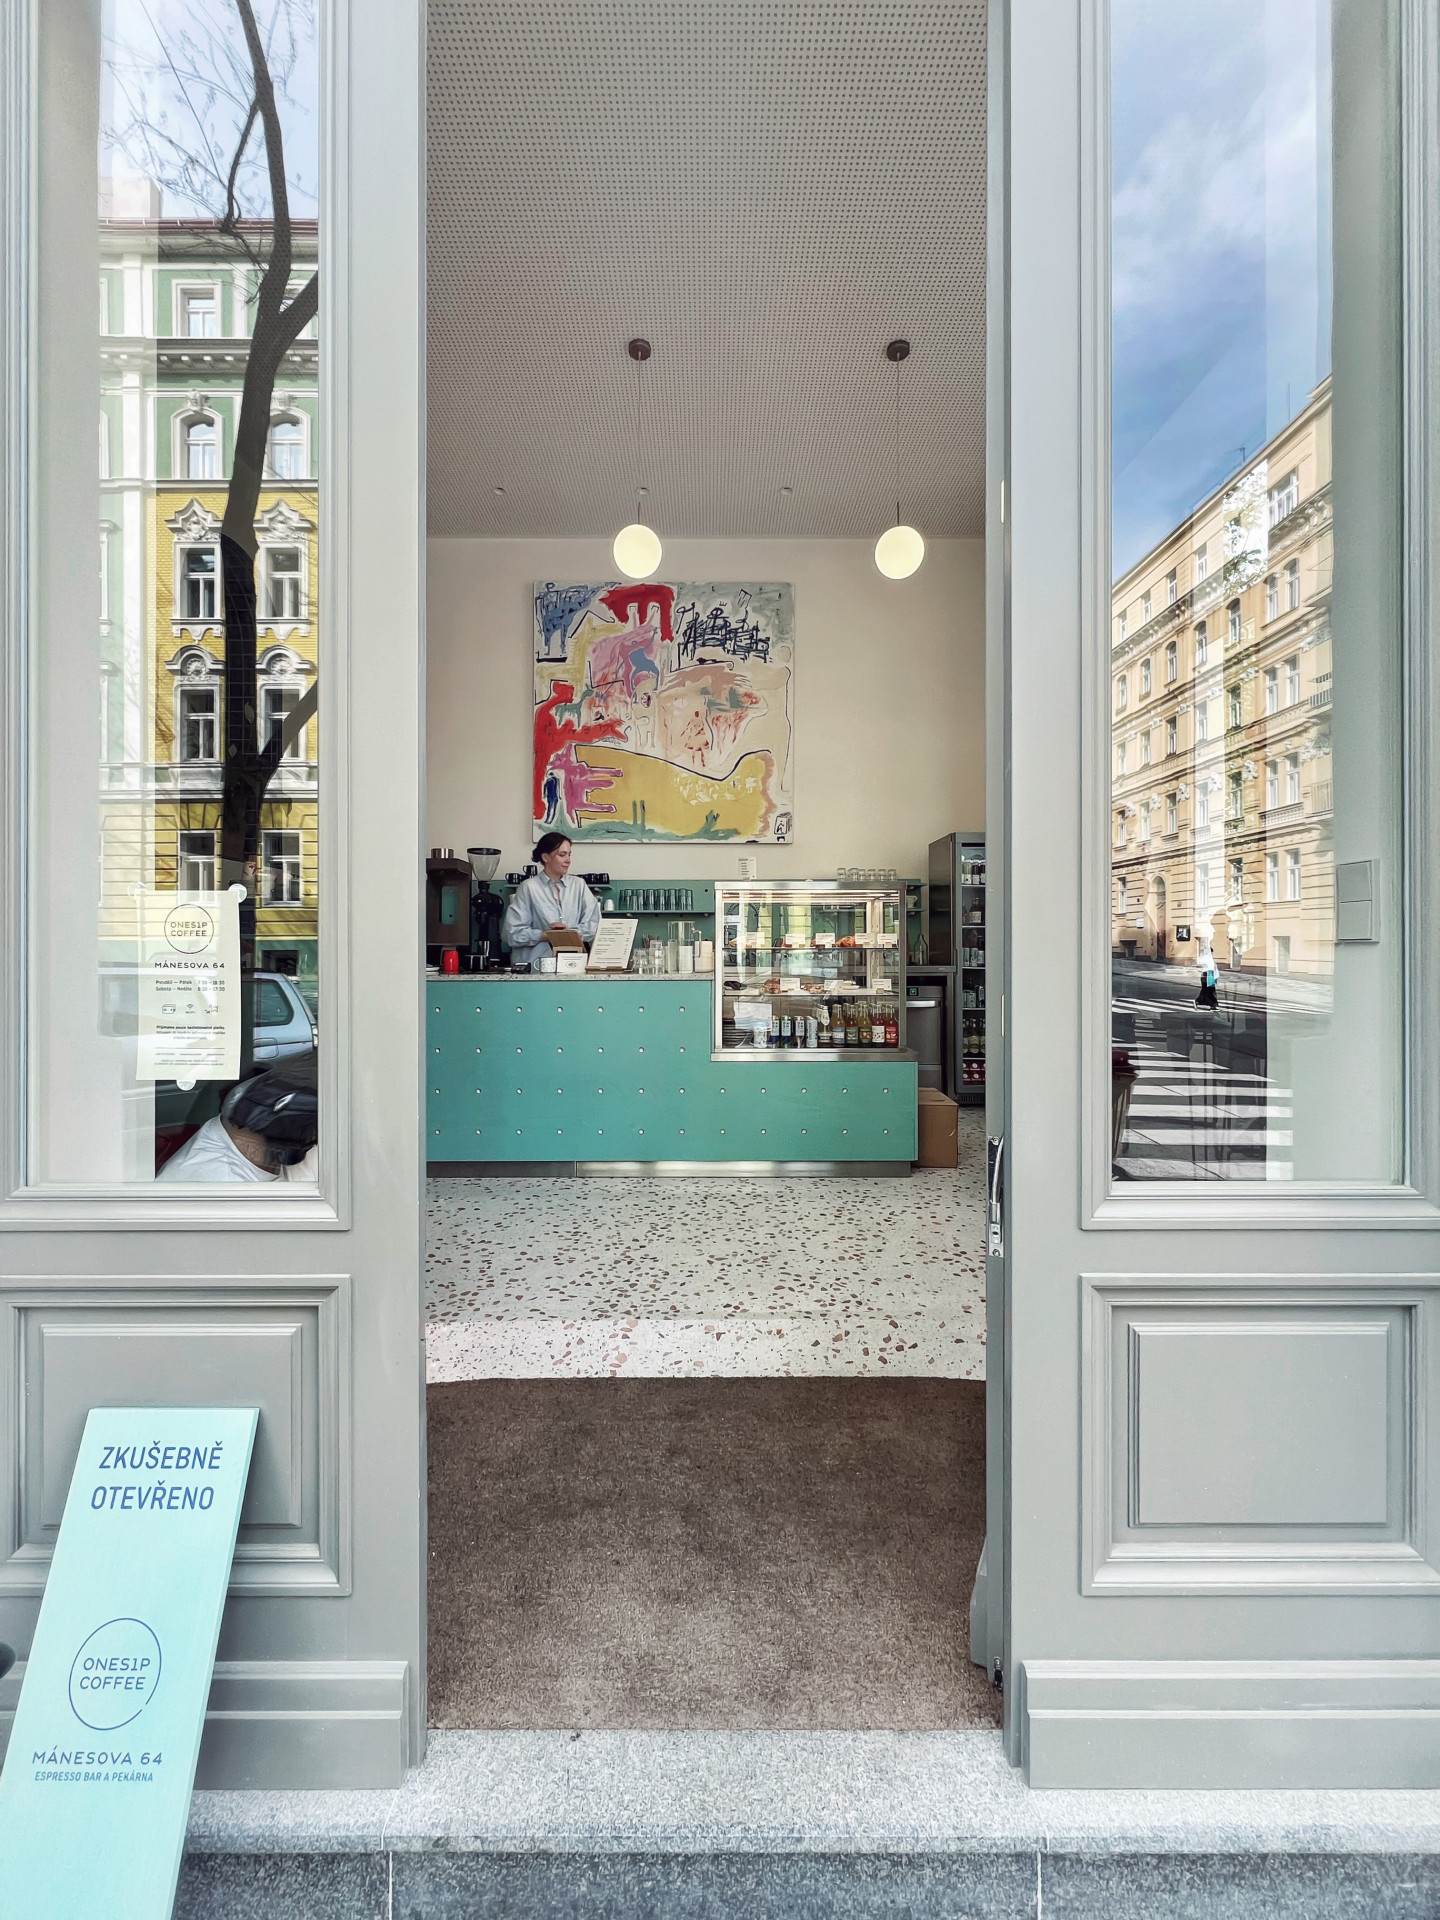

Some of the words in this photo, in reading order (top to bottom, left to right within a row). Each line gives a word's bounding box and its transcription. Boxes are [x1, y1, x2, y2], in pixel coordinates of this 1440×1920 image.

[170, 921, 208, 929] ONES1P
[154, 960, 209, 969] MÁNESOVA
[98, 1440, 223, 1470] ZKUŠEBNĚ
[91, 1480, 215, 1510] OTEVŘENO
[83, 1657, 151, 1671] ONES1P
[80, 1676, 146, 1690] COFFEE
[32, 1745, 132, 1765] MÁNESOVA
[140, 1752, 163, 1765] 64
[34, 1771, 82, 1781] ESPRESSO
[83, 1771, 102, 1781] BAR
[103, 1772, 110, 1781] A
[111, 1769, 153, 1782] PEKÁRNA
